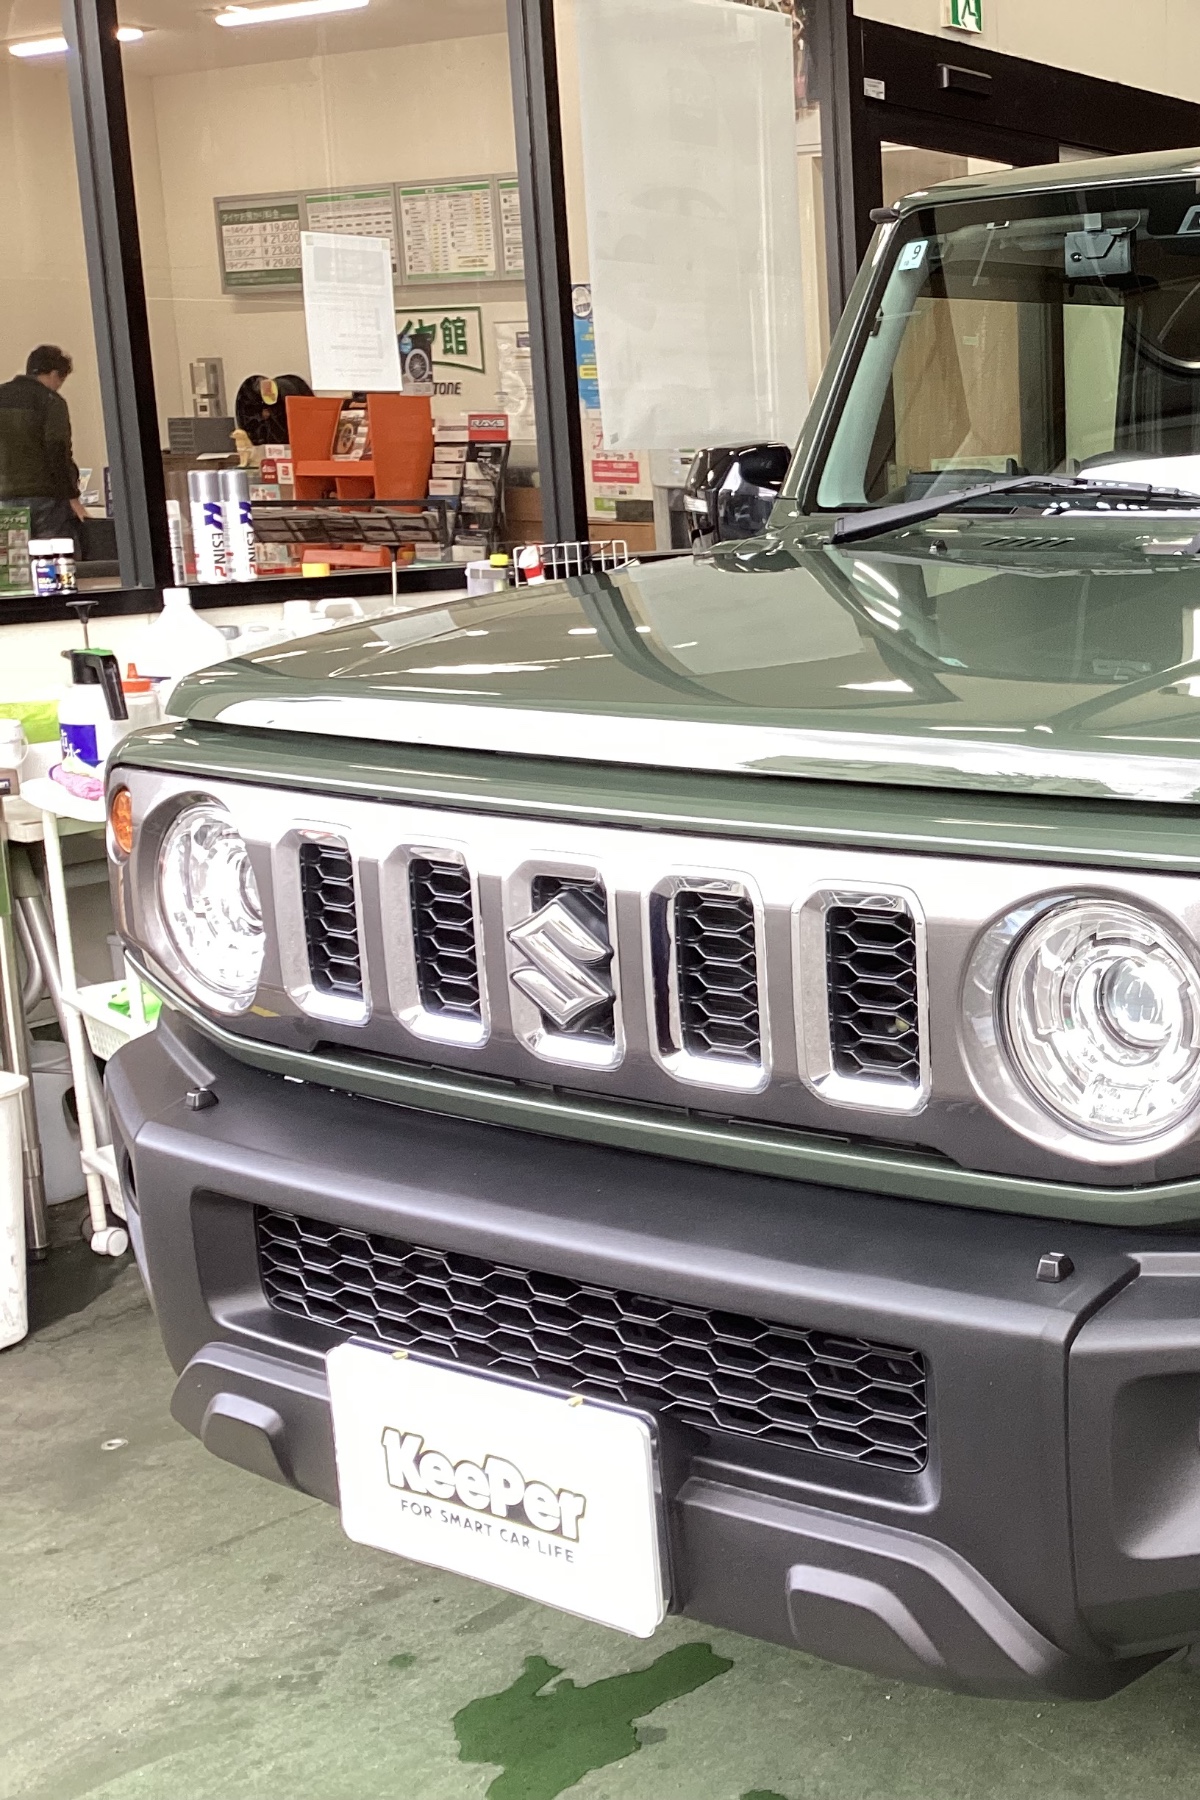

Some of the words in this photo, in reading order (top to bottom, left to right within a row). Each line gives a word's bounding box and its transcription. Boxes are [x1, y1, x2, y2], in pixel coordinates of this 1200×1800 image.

[911, 244, 922, 260] 9
[381, 1426, 586, 1543] KeePer
[401, 1499, 433, 1519] FOR
[440, 1509, 493, 1537] SMART
[499, 1528, 530, 1549] CAR
[537, 1540, 575, 1564] LIFE
